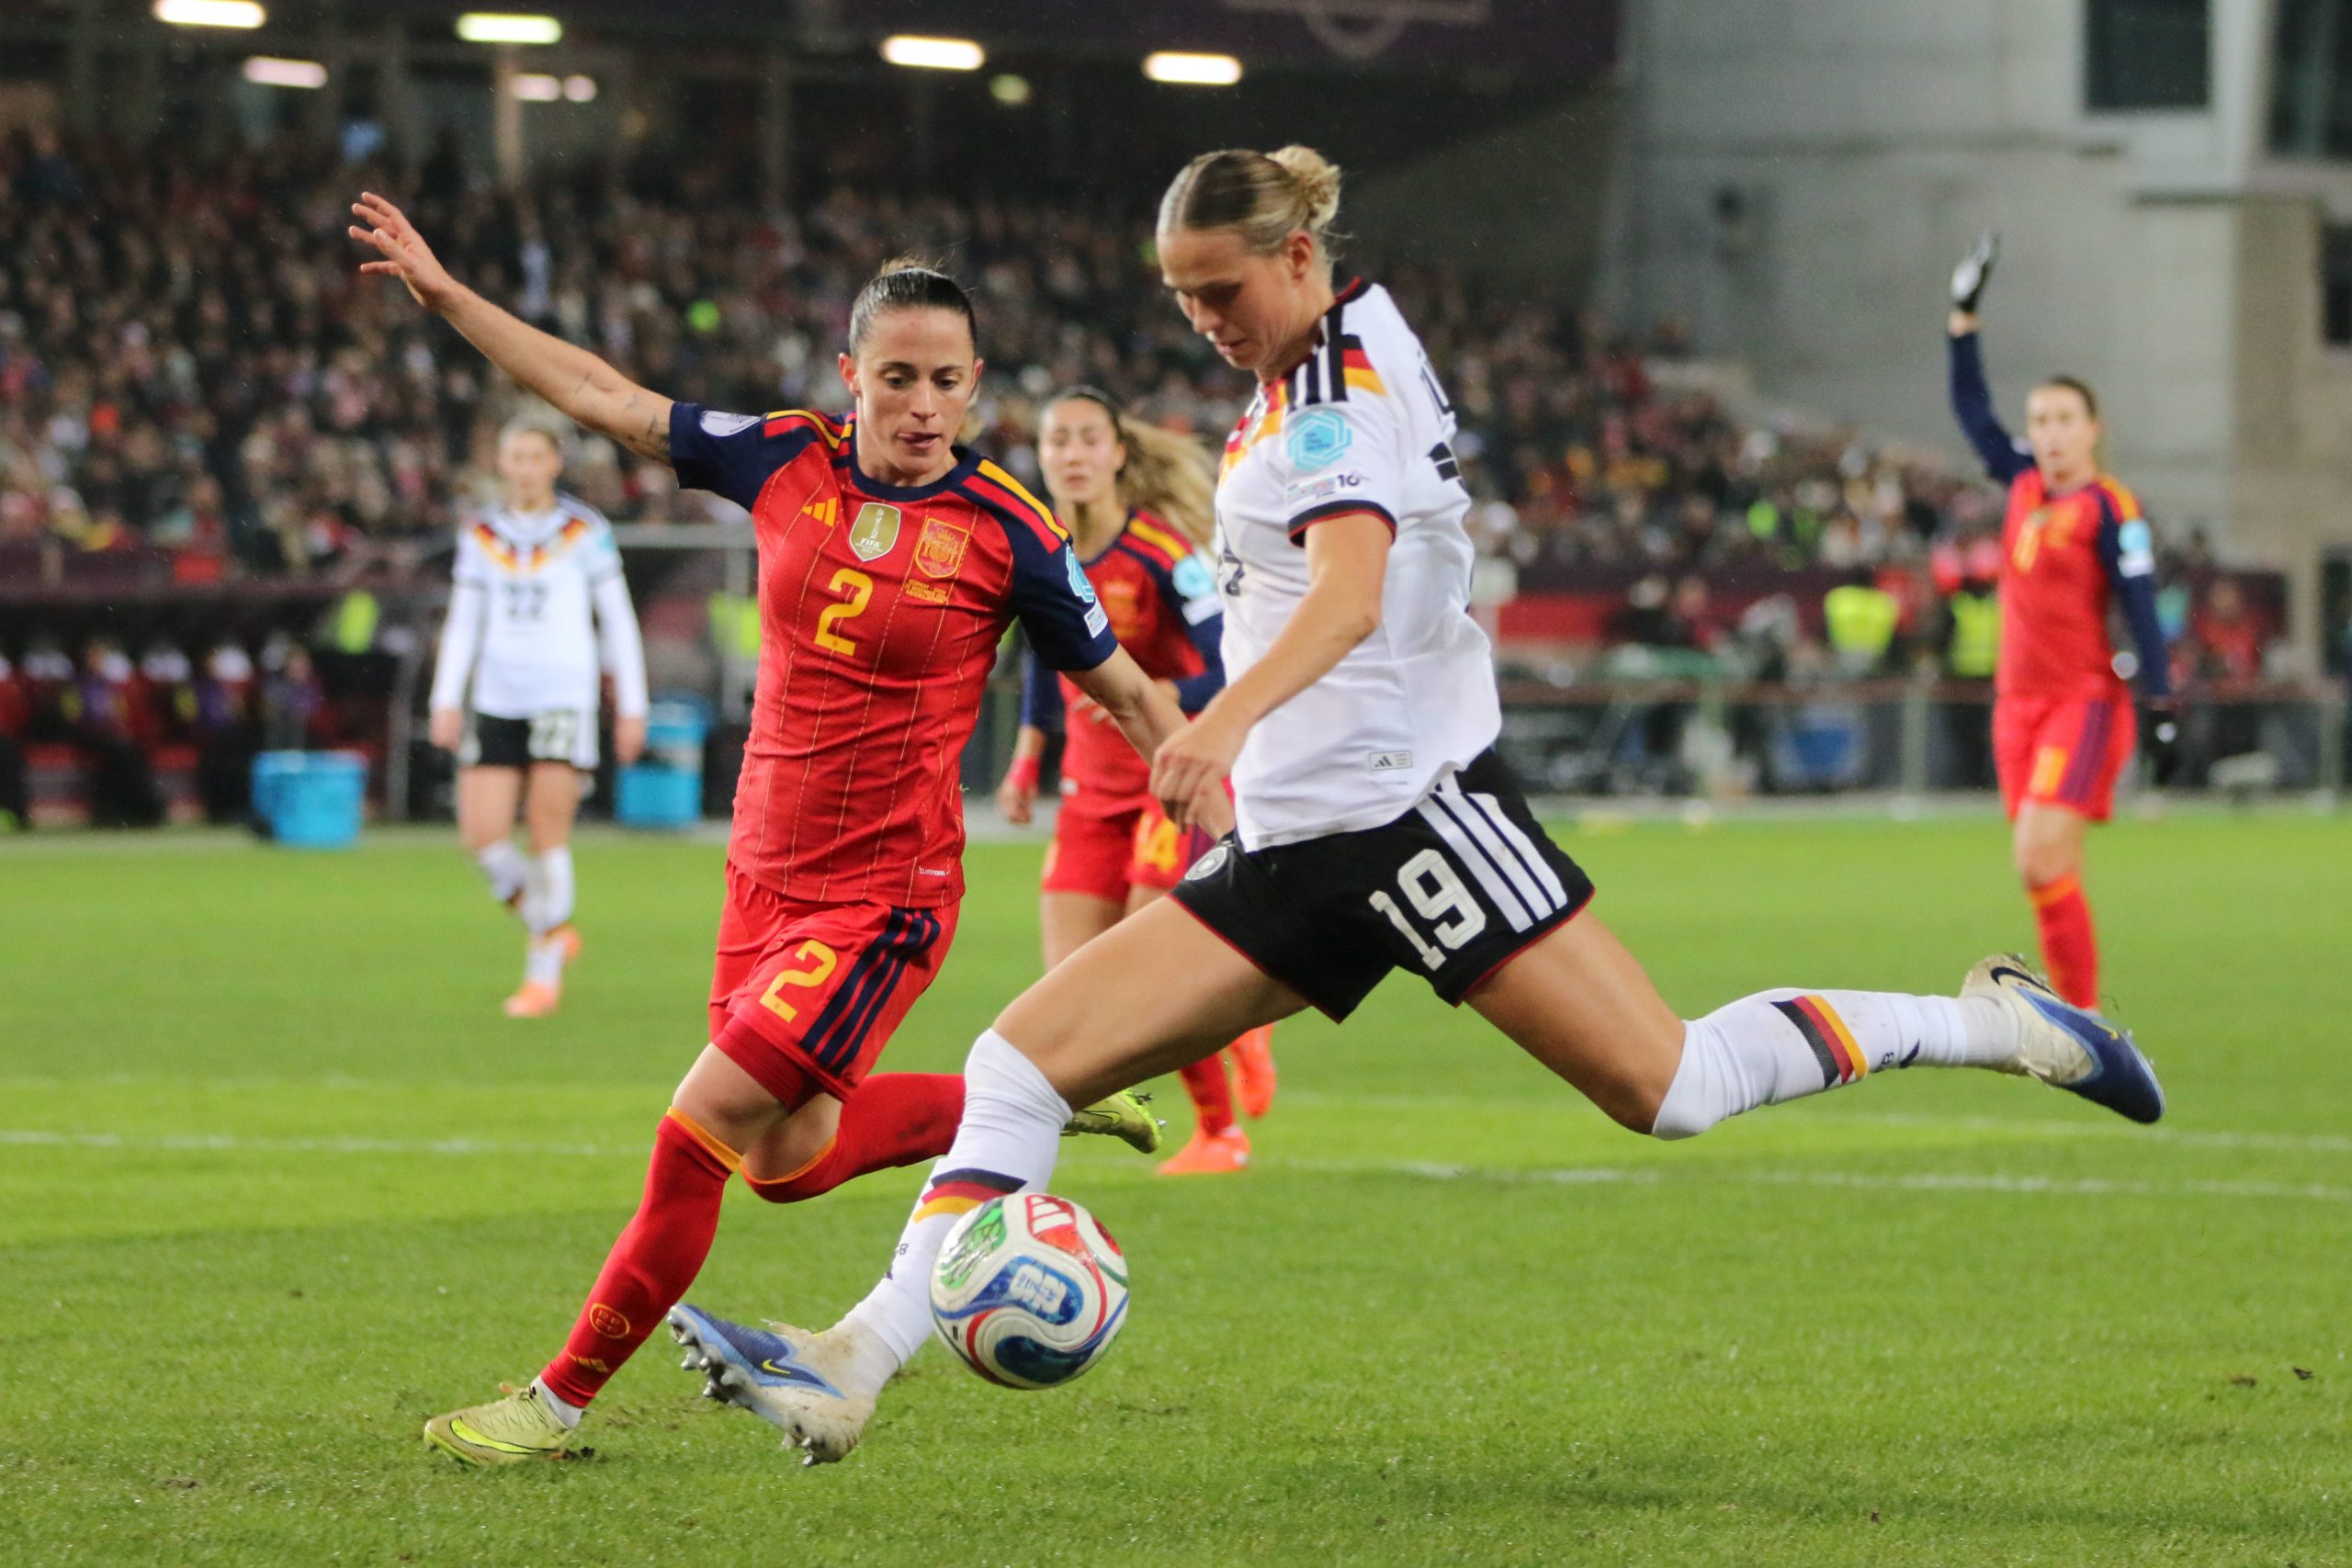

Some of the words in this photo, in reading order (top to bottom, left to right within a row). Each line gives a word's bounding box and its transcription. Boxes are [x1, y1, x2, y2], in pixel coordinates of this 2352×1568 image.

[860, 537, 880, 549] FIFA
[814, 568, 874, 657] 2
[1368, 849, 1487, 972] 19
[759, 939, 838, 1023] 2
